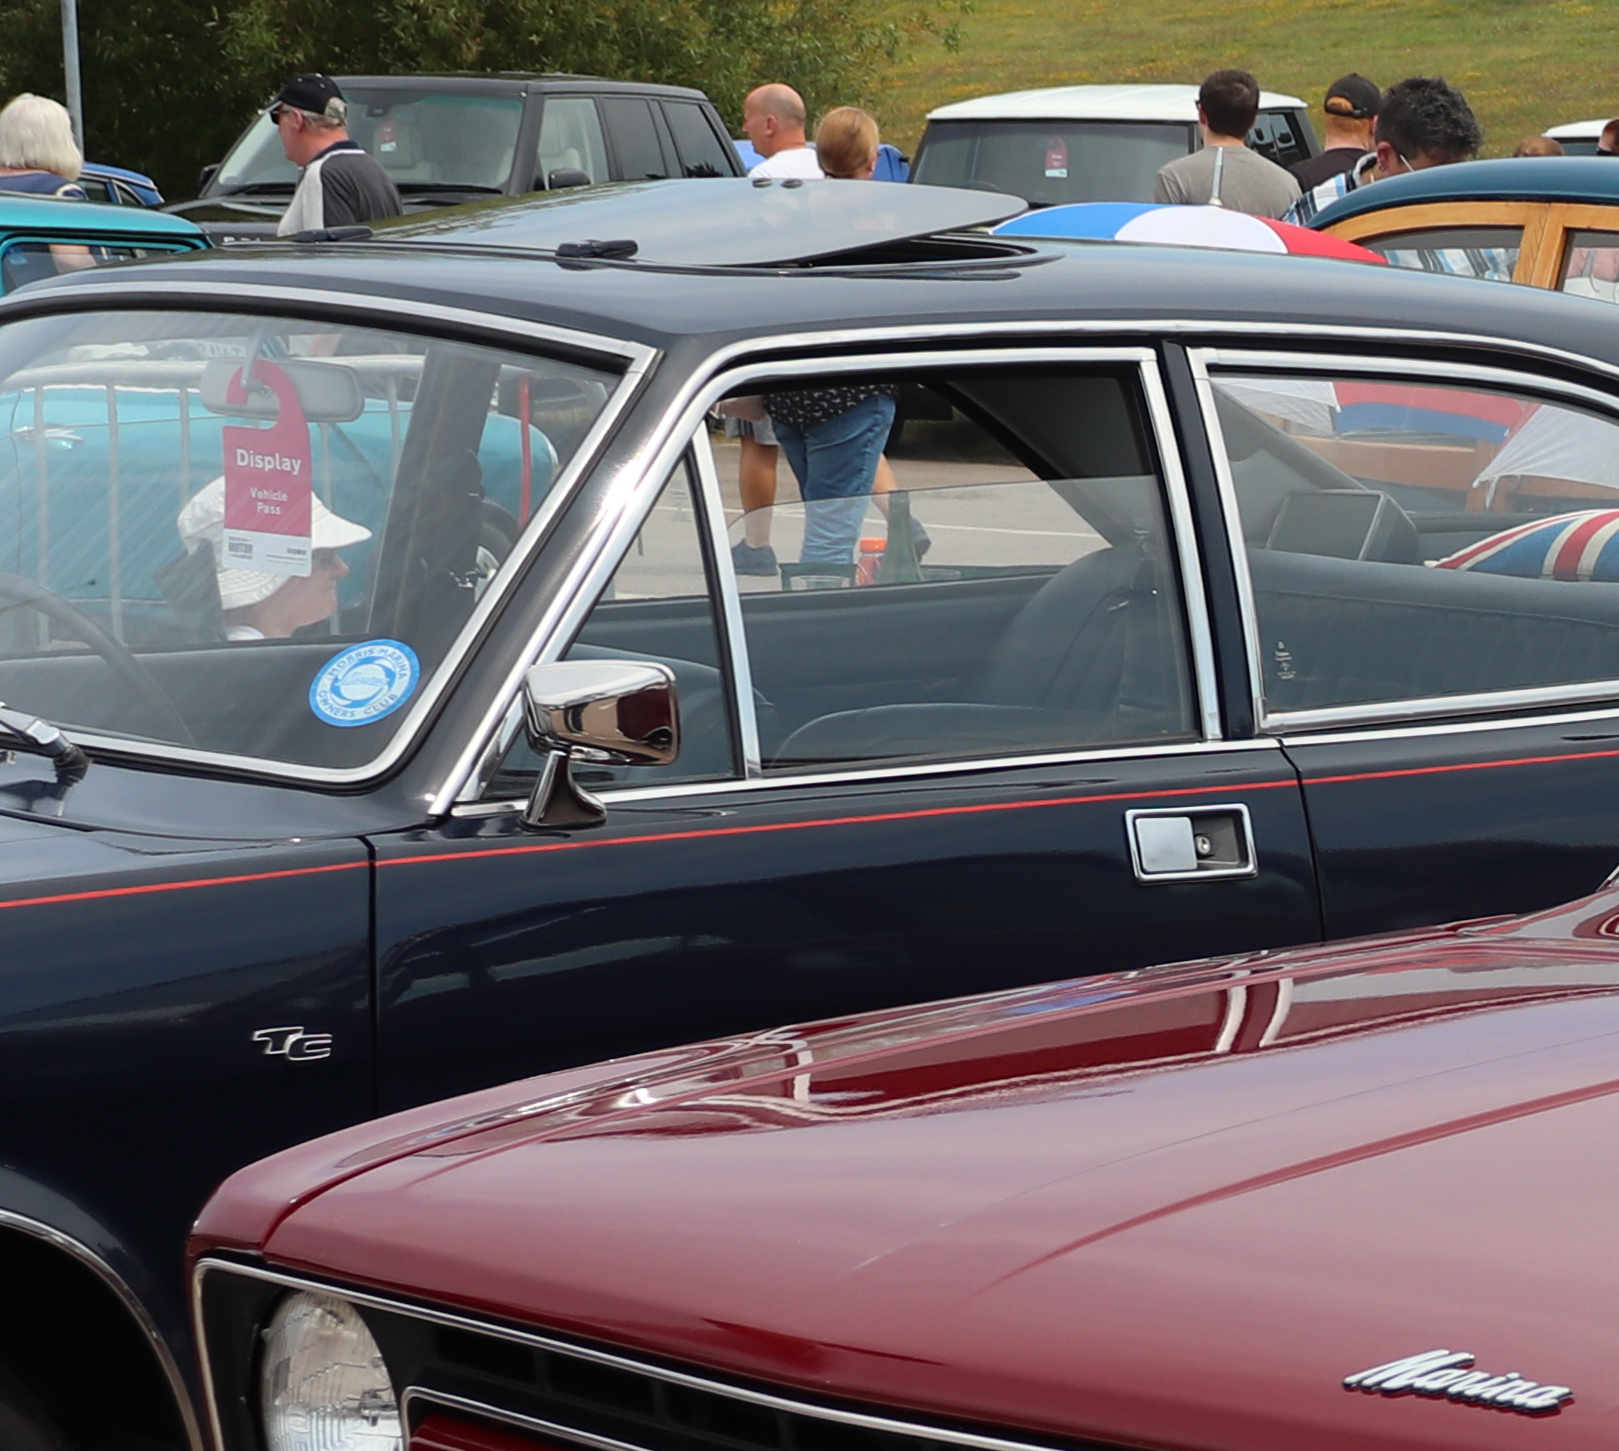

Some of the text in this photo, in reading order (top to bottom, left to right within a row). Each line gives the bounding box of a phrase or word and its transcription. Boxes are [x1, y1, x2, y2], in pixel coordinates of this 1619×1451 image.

[236, 448, 301, 474] Display
[250, 487, 288, 502] Vehicle
[257, 502, 281, 515] Pass
[327, 647, 408, 681] MORRIS MARINA
[316, 690, 398, 719] OWNERS CLUB
[252, 1026, 333, 1061] TC
[1342, 1349, 1573, 1412] Marina
